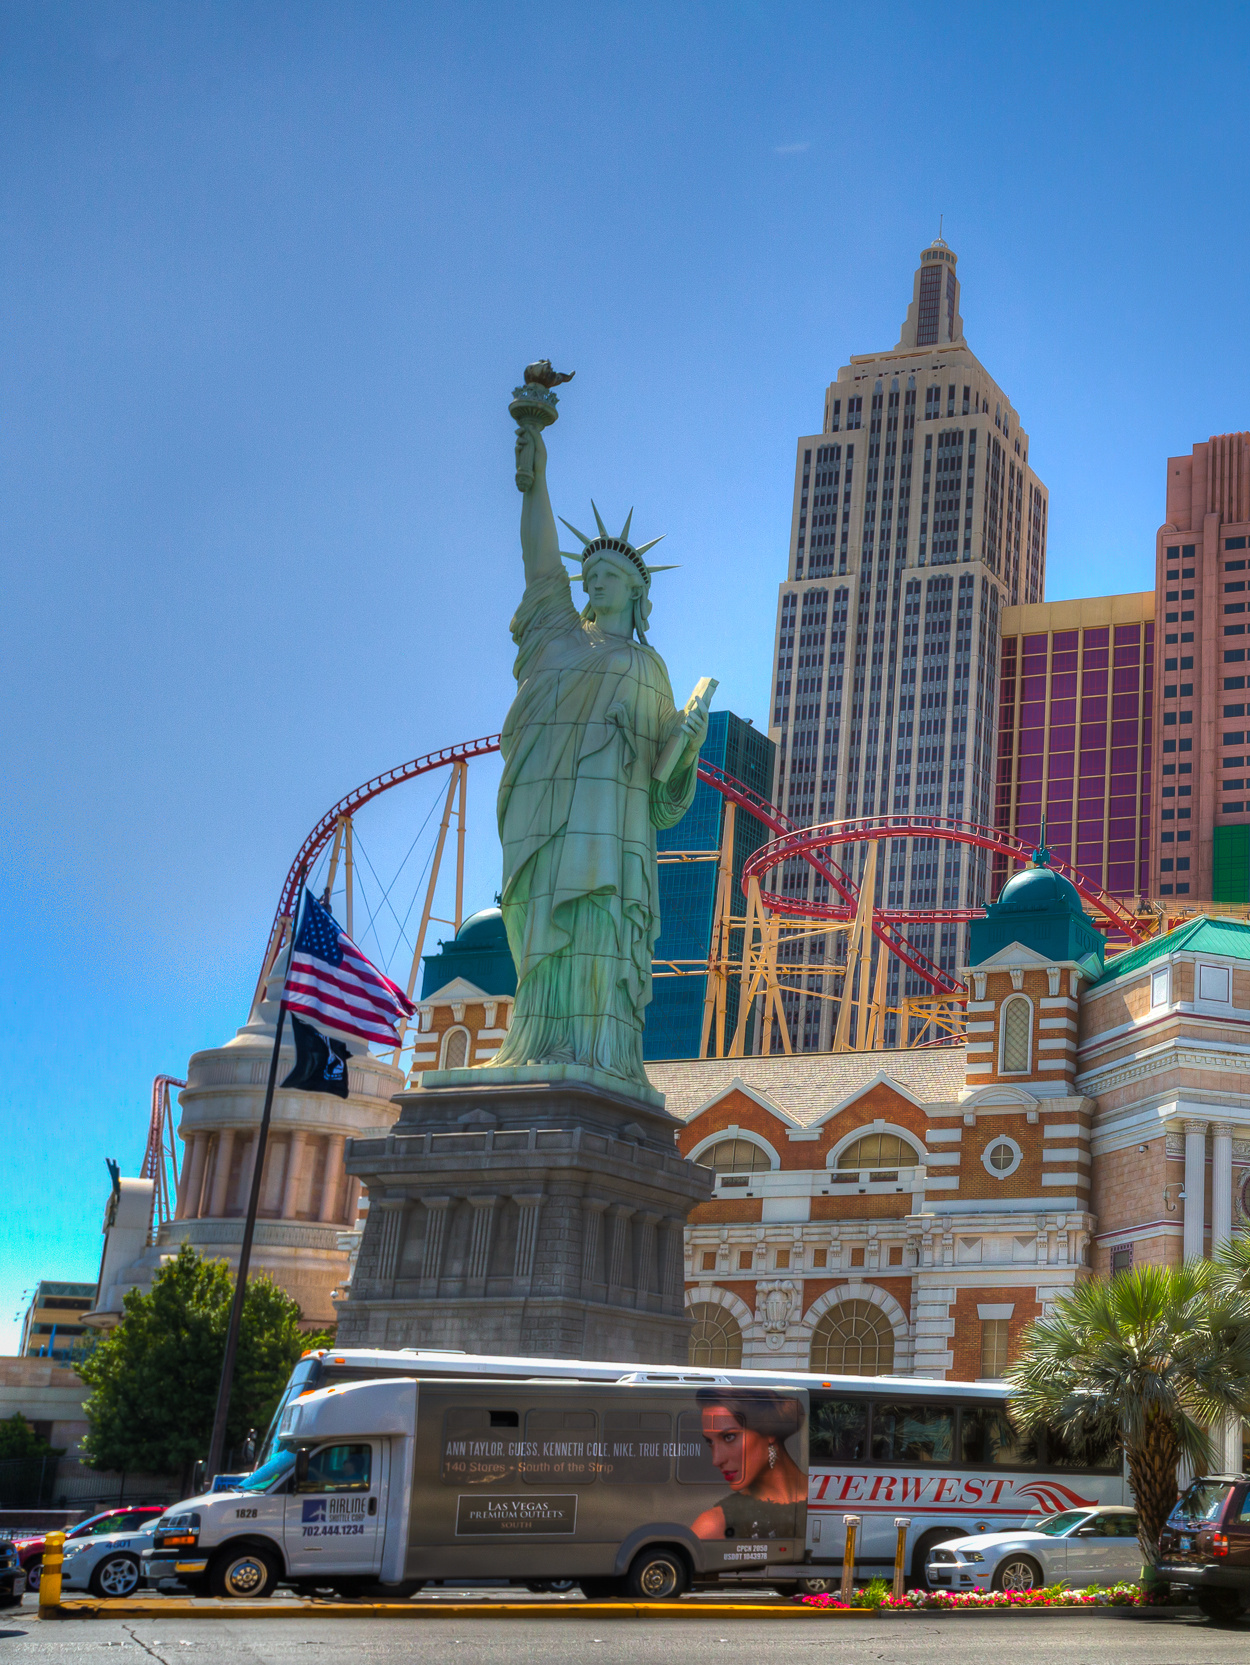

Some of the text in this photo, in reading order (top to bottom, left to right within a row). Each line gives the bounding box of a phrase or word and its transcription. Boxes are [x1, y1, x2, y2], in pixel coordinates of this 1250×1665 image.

[446, 1441, 466, 1456] ANN
[508, 1441, 540, 1457] GUESS,
[543, 1442, 583, 1457] KENNETH
[586, 1442, 610, 1458] COLE,
[613, 1442, 636, 1458] NIKE,
[639, 1442, 660, 1457] TRUE
[662, 1442, 701, 1457] RELIGION
[445, 1461, 614, 1474] 140 Stores South of the Strip
[808, 1474, 1014, 1504] TERWEST
[329, 1497, 366, 1514] AIRLINE
[488, 1501, 549, 1511] LAS VEGAS
[236, 1508, 258, 1518] 1828
[469, 1510, 563, 1519] PREMIUM OUTLETS
[302, 1524, 364, 1537] 702.444.1234
[501, 1521, 532, 1529] SOUTH
